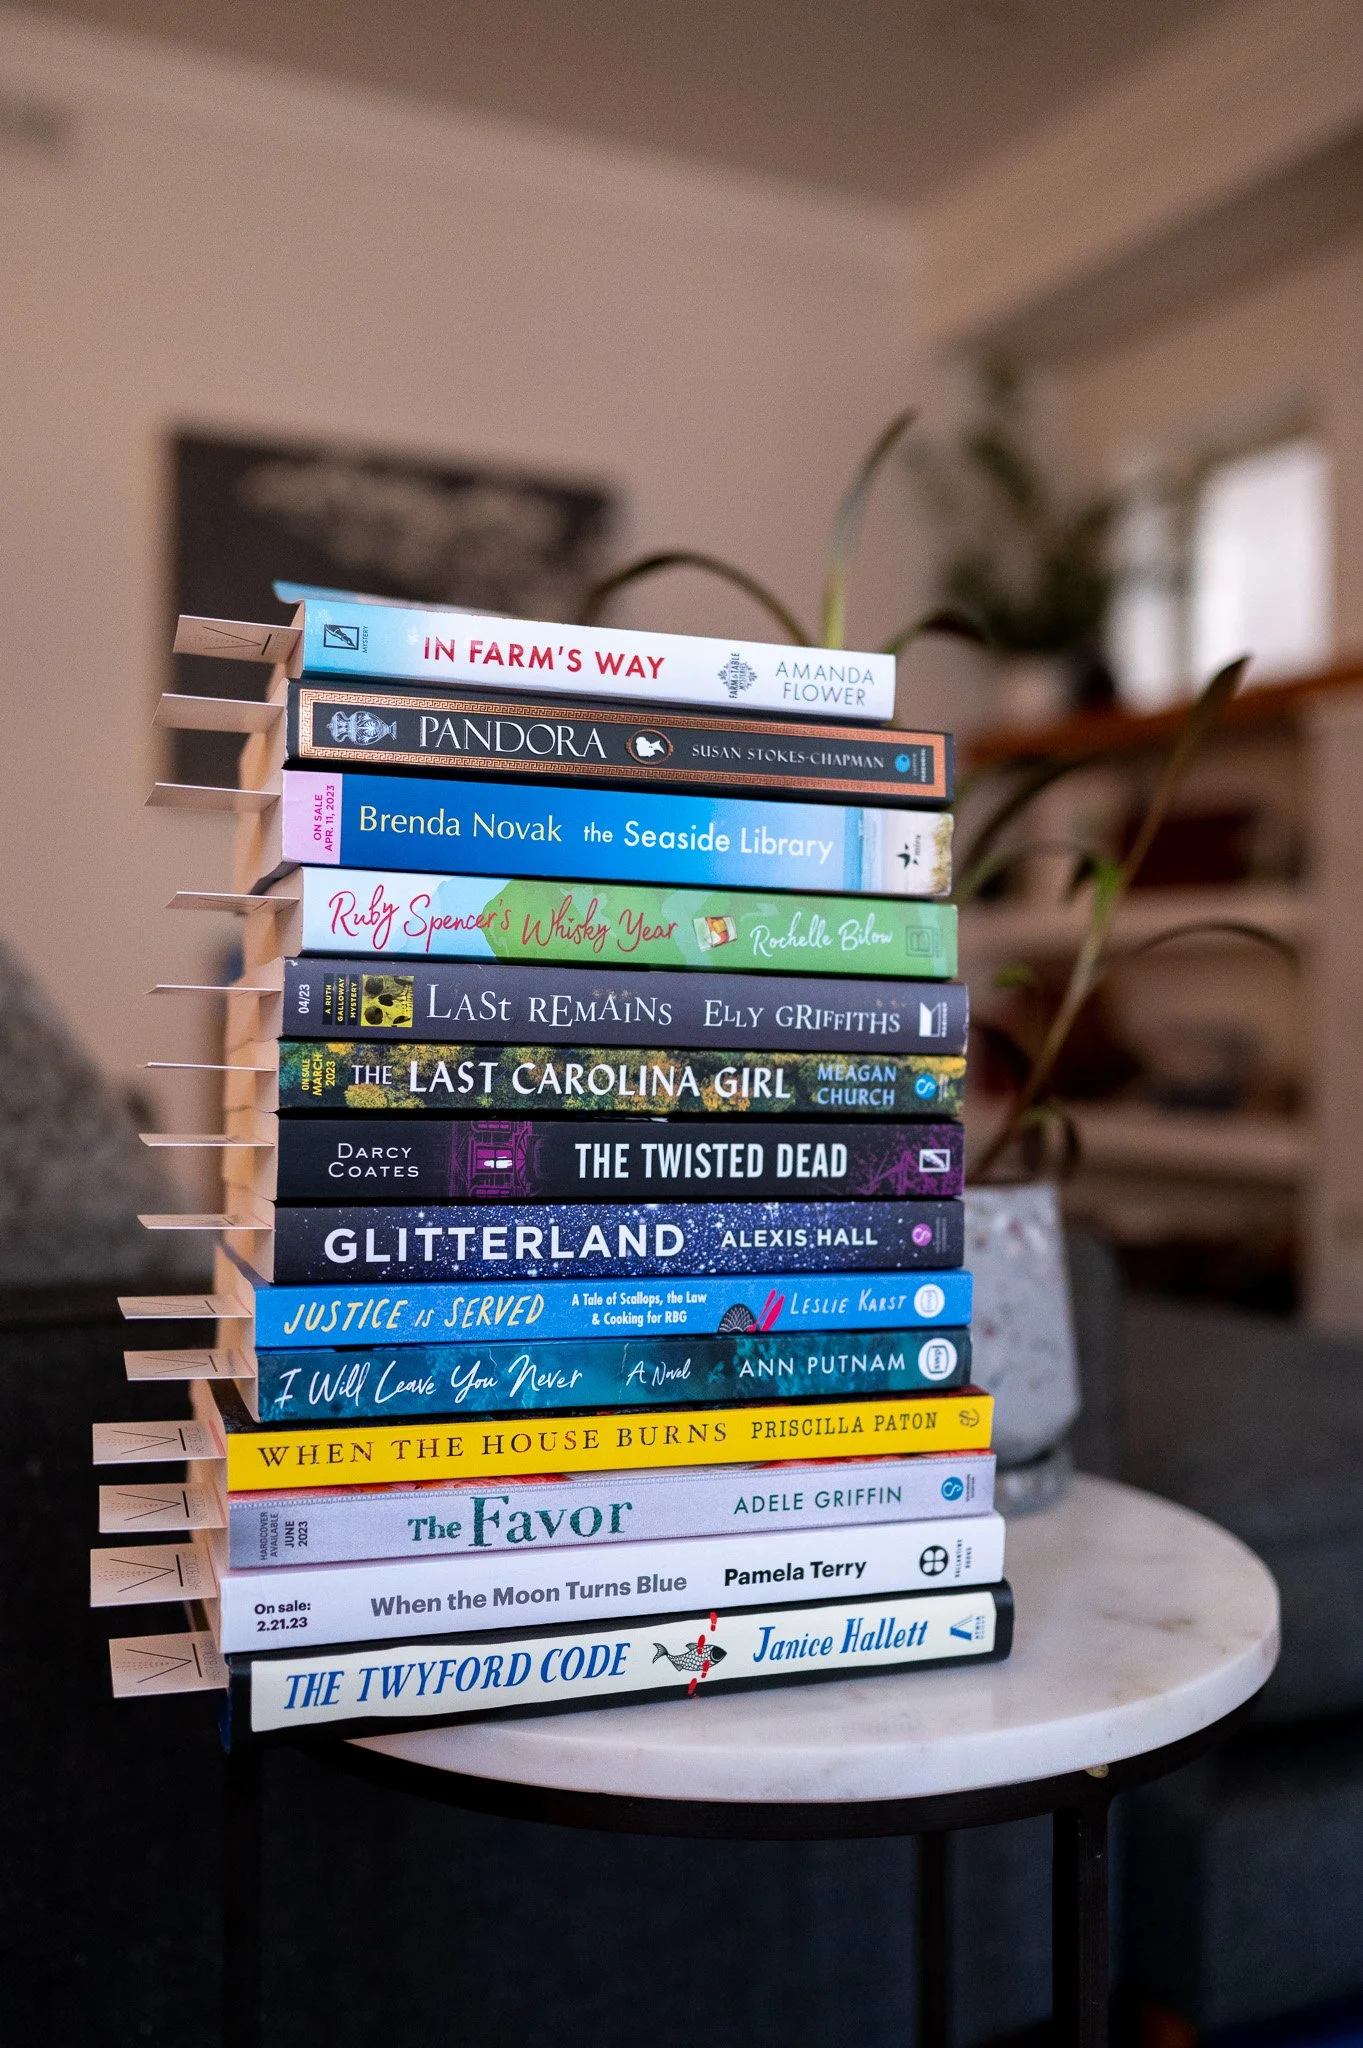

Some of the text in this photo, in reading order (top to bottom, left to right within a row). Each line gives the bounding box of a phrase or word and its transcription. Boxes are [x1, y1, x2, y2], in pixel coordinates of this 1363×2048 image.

[424, 636, 665, 679] IN FARM'S WAY
[731, 652, 740, 673] TABLE
[775, 661, 875, 685] AMANDA
[729, 678, 739, 699] FARM
[783, 682, 866, 706] FLOWER
[419, 715, 607, 759] PANDORA
[692, 744, 884, 769] SUSAN STOKES-CHAPMAN
[326, 785, 335, 809] 2023
[314, 794, 323, 841] ON SALE
[359, 805, 562, 841] Brenda Novak
[324, 826, 334, 852] APR.
[583, 820, 834, 864] the Seaside Library
[328, 884, 677, 953] Ruby Spencer's Whisky Year
[750, 911, 832, 957] Rochelle
[838, 912, 893, 951] Bilow
[298, 983, 310, 1014] 04/23
[337, 978, 345, 1022] GALLOWAY
[703, 999, 901, 1034] ELLY GRIFFITHS
[301, 1059, 310, 1091] ON SALE
[313, 1054, 324, 1096] MARCH
[326, 1061, 336, 1087] 2023
[351, 1061, 792, 1099] THE LAST CAROLINA GIRL
[817, 1064, 897, 1083] MEAGAN
[817, 1087, 896, 1107] CHURCH
[338, 1143, 412, 1160] DARCY
[575, 1143, 848, 1179] THE TWISTED DEAD
[328, 1161, 419, 1178] COATES
[324, 1224, 685, 1264] GLITTERLAND
[721, 1227, 878, 1248] ALEXIS HALL
[572, 1290, 707, 1306] A Tale of Scallops, the Law
[790, 1287, 908, 1315] LESLIE KARST
[284, 1298, 408, 1335] JUSTICE
[444, 1293, 545, 1329] SERVED
[592, 1311, 687, 1327] & Cooking for RBG
[626, 1358, 691, 1387] A Novel
[739, 1352, 905, 1378] ANN PUTNAM
[274, 1354, 583, 1409] I Will Leave You Never
[751, 1411, 938, 1439] PRISCILLA PATON
[258, 1422, 727, 1467] WHEN THE HOUSE BURNS
[734, 1486, 902, 1515] ADELE GRIFFIN
[270, 1513, 279, 1558] AVAILABLE
[285, 1520, 295, 1548] JUNE
[298, 1520, 308, 1547] 2023
[408, 1495, 632, 1547] The Favor
[260, 1511, 268, 1561] HARDCOVER
[724, 1560, 867, 1587] Pamela Terry
[254, 1600, 311, 1616] On sale:
[371, 1575, 687, 1617] When the Moon Turns Blue
[256, 1617, 308, 1632] 2.21.23
[753, 1617, 929, 1663] Janice Hallett
[283, 1642, 631, 1710] THE TWYFORD CODE
